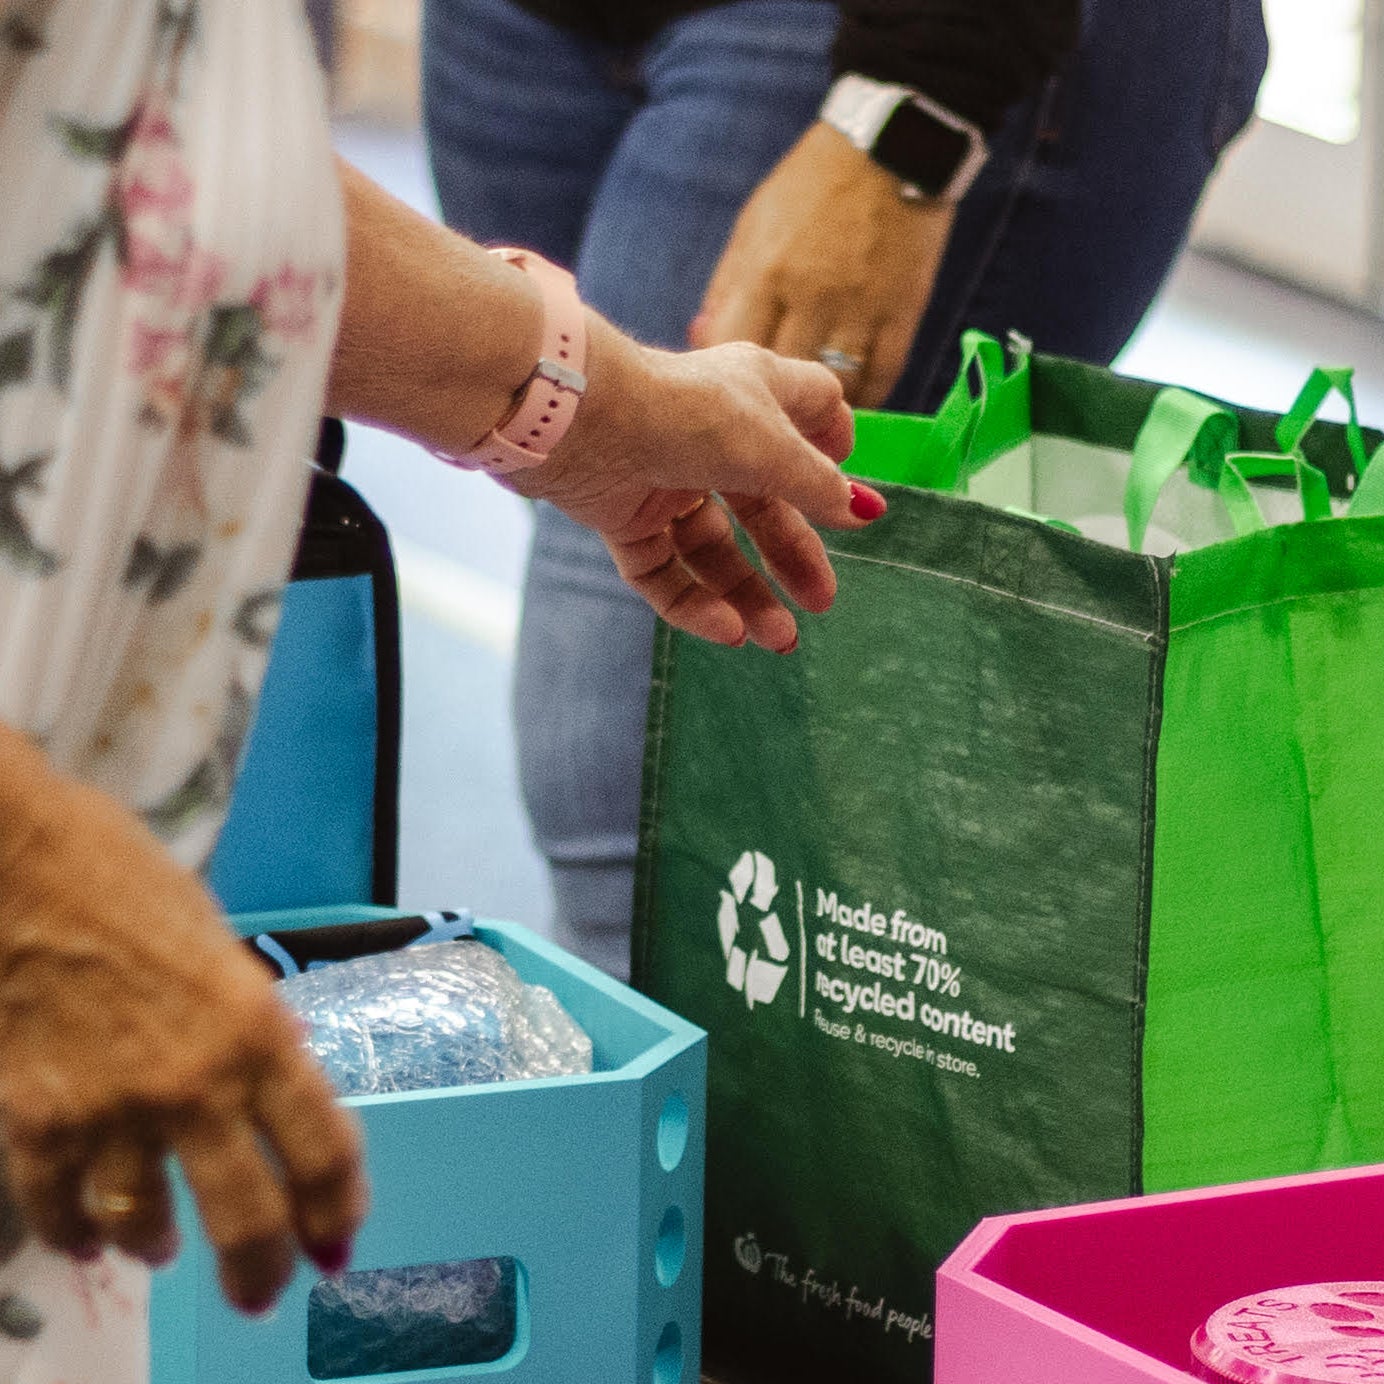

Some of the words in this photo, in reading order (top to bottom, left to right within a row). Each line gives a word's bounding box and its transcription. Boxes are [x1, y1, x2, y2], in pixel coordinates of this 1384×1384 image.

[815, 887, 888, 937] Made
[889, 909, 948, 956] from
[815, 931, 838, 962] at
[840, 933, 907, 982] least
[909, 952, 962, 998] 70%
[815, 970, 916, 1022] recycled
[919, 1002, 1017, 1054] content
[853, 1022, 867, 1045] &
[869, 1031, 925, 1060] recycle
[935, 1050, 981, 1080] store.
[764, 1251, 797, 1288] The
[800, 1267, 843, 1306] fresh
[845, 1284, 885, 1320] food
[886, 1307, 933, 1344] people
[1226, 1298, 1305, 1364] TREATS
